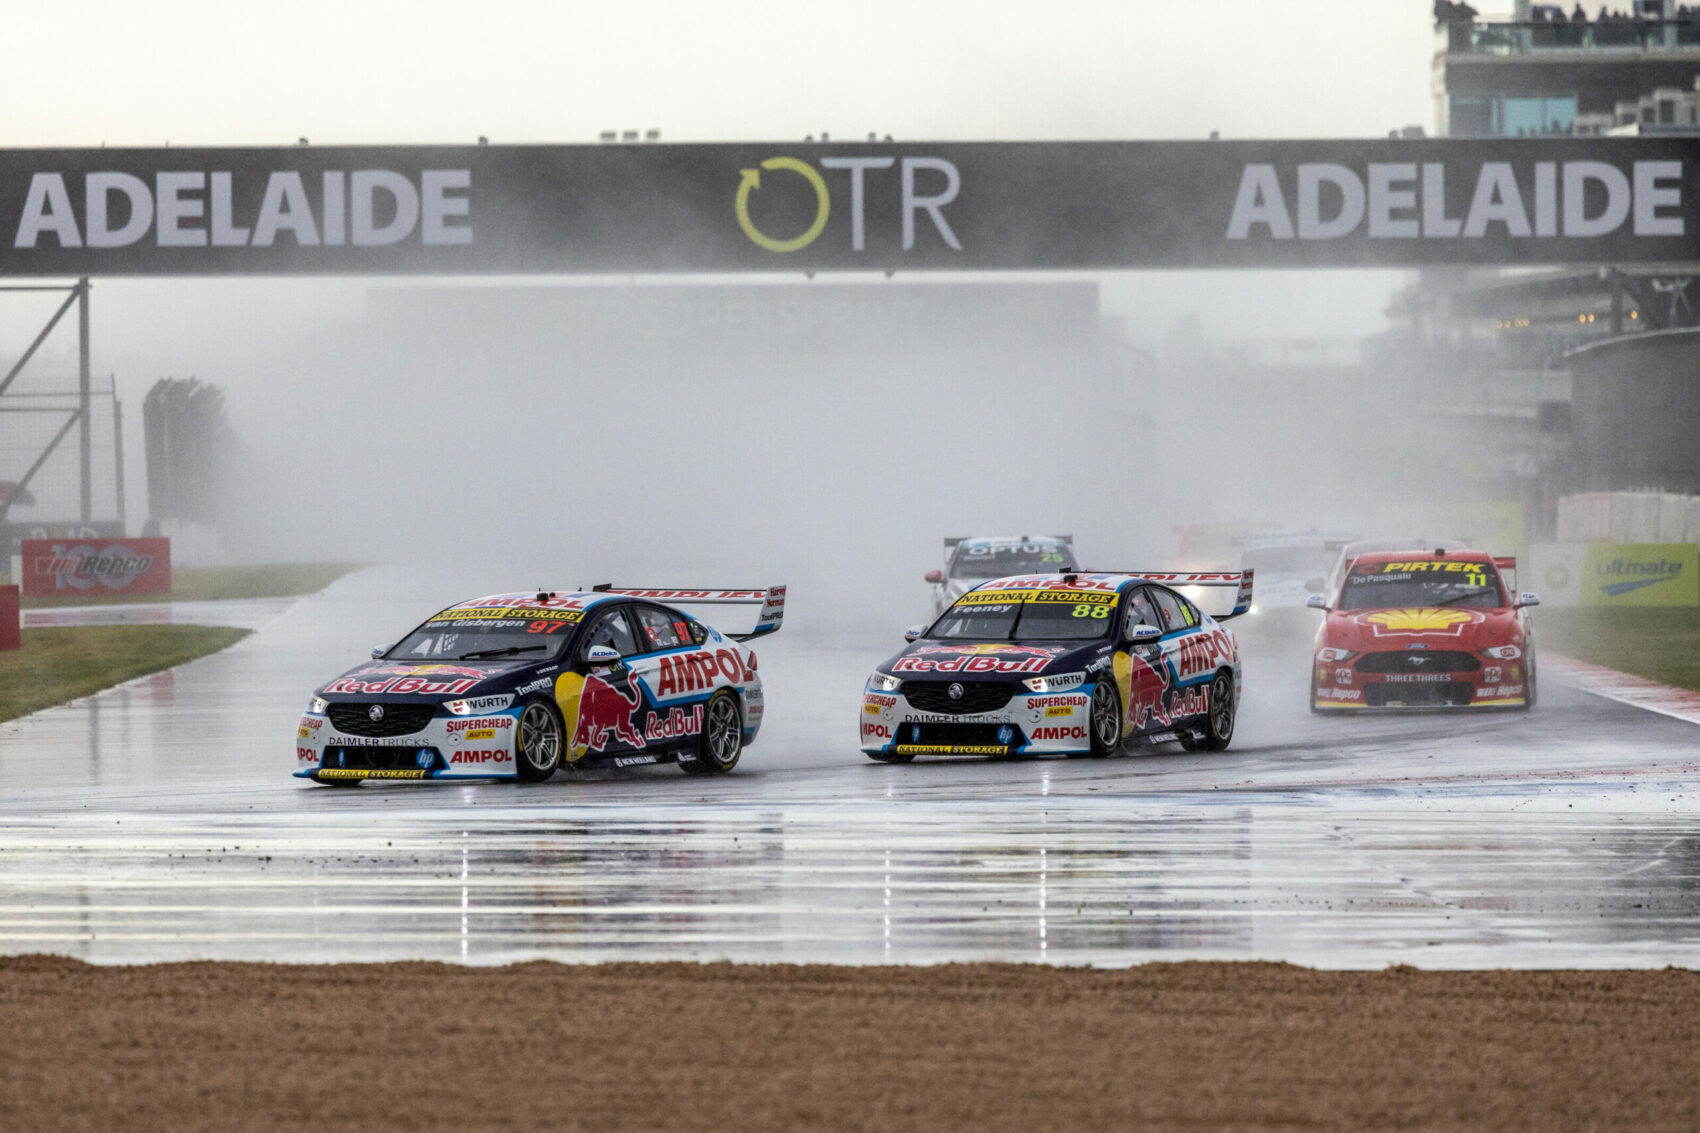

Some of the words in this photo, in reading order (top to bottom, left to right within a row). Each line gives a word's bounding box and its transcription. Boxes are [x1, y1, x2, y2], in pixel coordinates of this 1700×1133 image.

[735, 157, 962, 252] OTR
[1225, 160, 1685, 240] ADELAIDE
[14, 170, 474, 248] ADELAIDE
[1041, 553, 1064, 564] 25
[79, 556, 152, 576] Repco
[1383, 562, 1486, 573] PIRTEK
[981, 579, 1117, 591] AMPOL
[1353, 576, 1366, 584] De
[1367, 573, 1412, 583] Pasquale
[1465, 573, 1487, 587] 11
[961, 592, 1034, 604] NATIONAL
[1039, 592, 1111, 604] STORAGE
[438, 609, 504, 620] NATIONAL
[506, 609, 580, 621] STORAGE
[953, 605, 1013, 614] Feeney
[1072, 604, 1110, 619] 88
[452, 619, 526, 629] Gisbergen
[526, 620, 567, 634] 97
[673, 622, 690, 641] 97
[657, 647, 754, 697] AMPOL
[1386, 674, 1414, 682] THREE
[1416, 673, 1451, 682] THREES
[515, 677, 552, 697] ToolPRO
[1027, 696, 1088, 710] SUPERCHEAP
[905, 714, 960, 724] DAIMLER
[961, 714, 1011, 724] TRUCKS
[1048, 708, 1071, 716] AUTO
[446, 717, 513, 733] SUPERCHEAP
[468, 730, 493, 738] AUTO
[1000, 727, 1014, 743] hp
[1030, 726, 1087, 740] AMPOL
[329, 736, 380, 747] DAIMLER
[381, 737, 430, 747] TRUCKS
[450, 749, 513, 763] AMPOL
[898, 745, 950, 754] NATIONAL
[951, 745, 1004, 755] STORAGE
[420, 750, 434, 768] hp
[319, 770, 368, 779] NATIONAL
[369, 769, 419, 778] STORAGE
